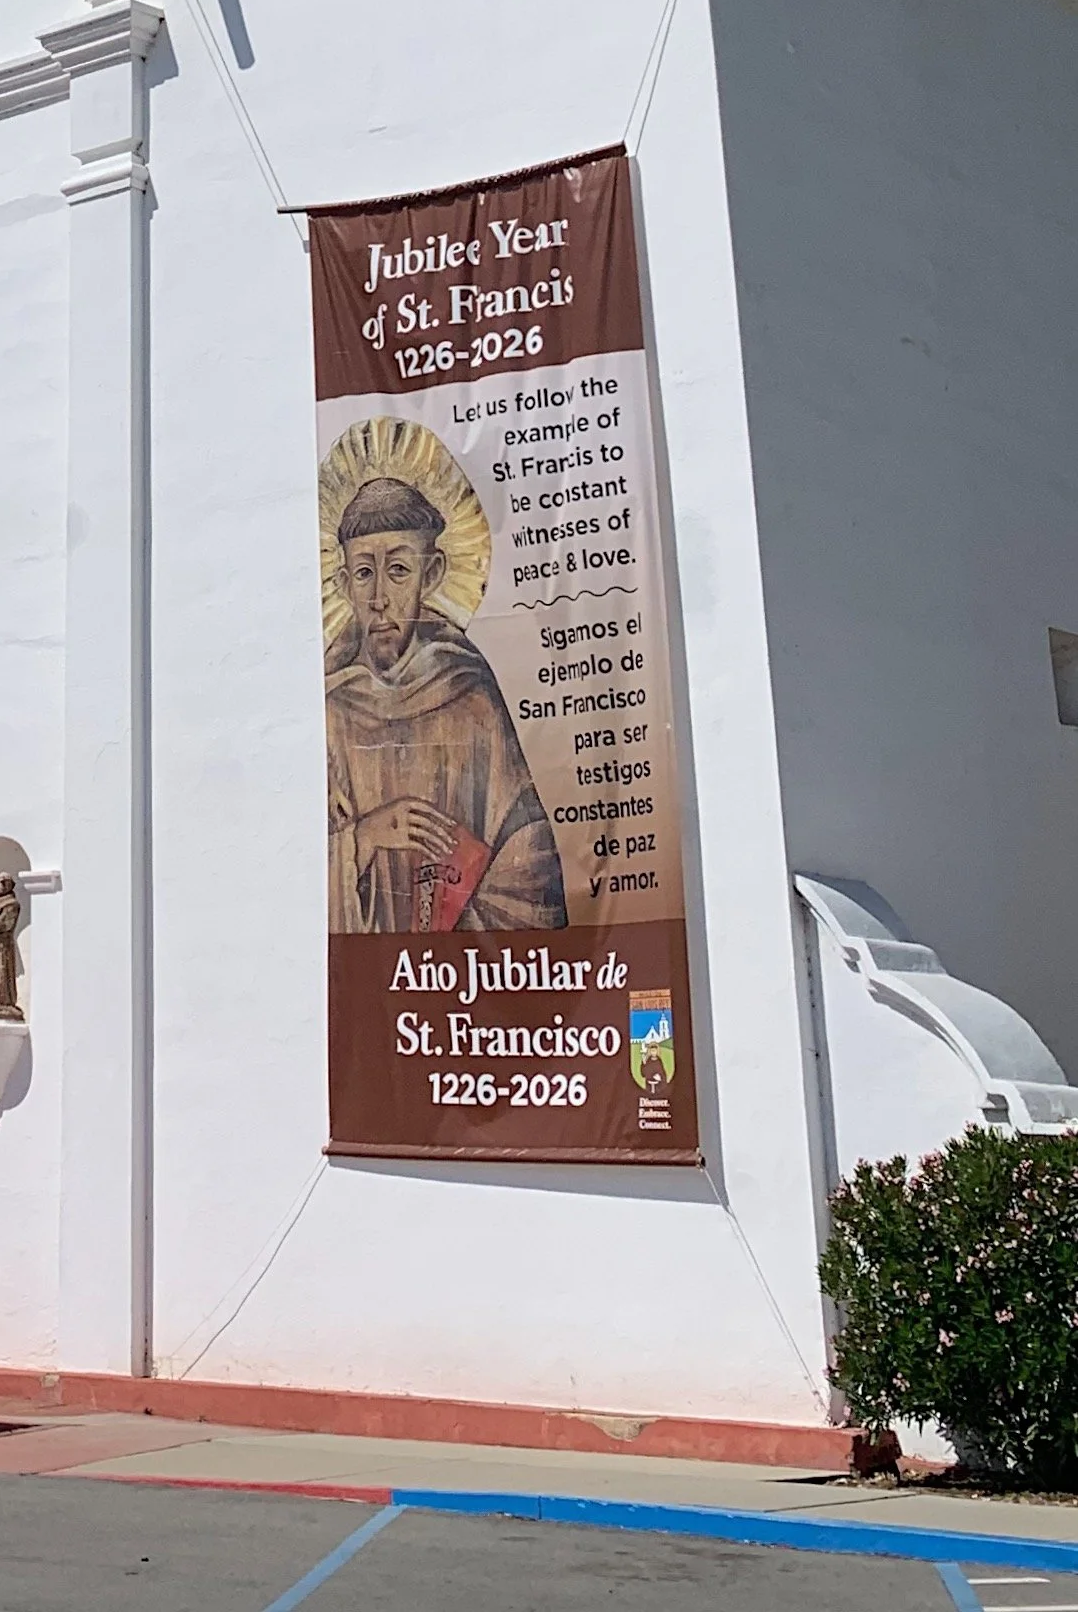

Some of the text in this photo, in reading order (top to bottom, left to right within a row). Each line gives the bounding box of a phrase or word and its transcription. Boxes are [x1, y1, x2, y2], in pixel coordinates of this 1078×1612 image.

[364, 218, 568, 293] Jubilee Year
[362, 268, 574, 350] of St. Francis
[395, 325, 544, 379] 1226-2026
[453, 403, 480, 424] Let
[486, 398, 507, 416] us
[580, 377, 618, 398] the
[504, 407, 621, 445] example of
[492, 461, 516, 483] St.
[600, 444, 624, 463] to
[510, 494, 531, 514] be
[512, 508, 631, 548] witnesses of
[513, 546, 636, 587] peace & love.
[541, 612, 642, 650] Sigamos el
[538, 649, 644, 687] ejemplo de
[519, 687, 646, 720] San Francisco
[574, 723, 649, 754] para ser
[576, 760, 651, 786] testigos
[554, 796, 654, 823] constantes
[593, 833, 656, 858] de paz
[589, 870, 659, 898] y amor.
[389, 947, 628, 1005] Año Jubilar de
[396, 1012, 621, 1058] St. Francisco
[428, 1072, 587, 1106] 1226-2026
